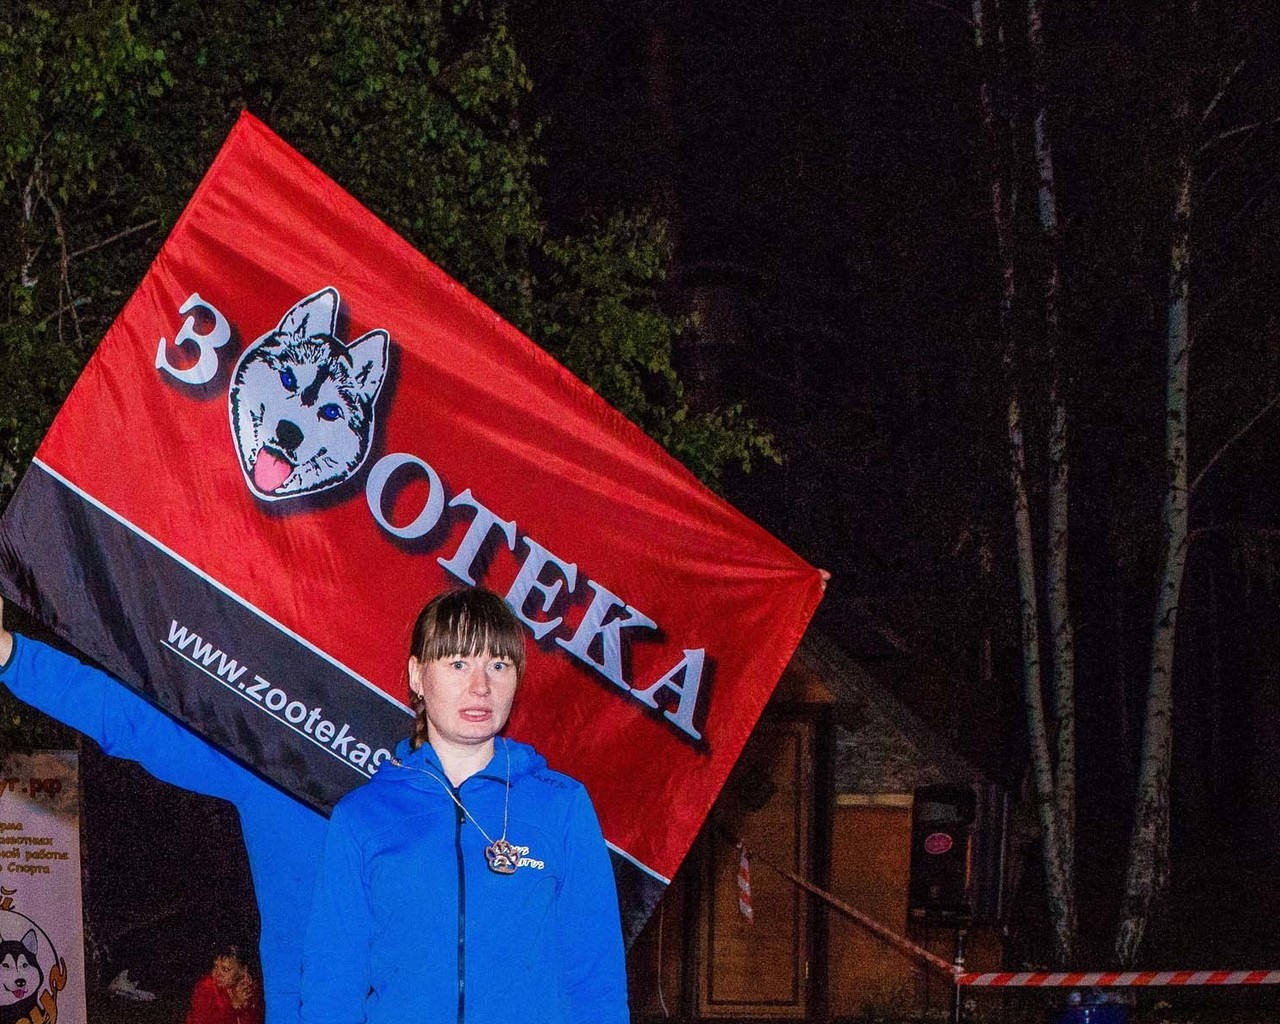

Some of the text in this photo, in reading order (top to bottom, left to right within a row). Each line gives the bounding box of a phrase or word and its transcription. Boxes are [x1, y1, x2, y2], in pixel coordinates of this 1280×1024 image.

[366, 452, 705, 740] ОТЕКА
[25, 849, 69, 861] работы
[7, 862, 52, 876] Спорта
